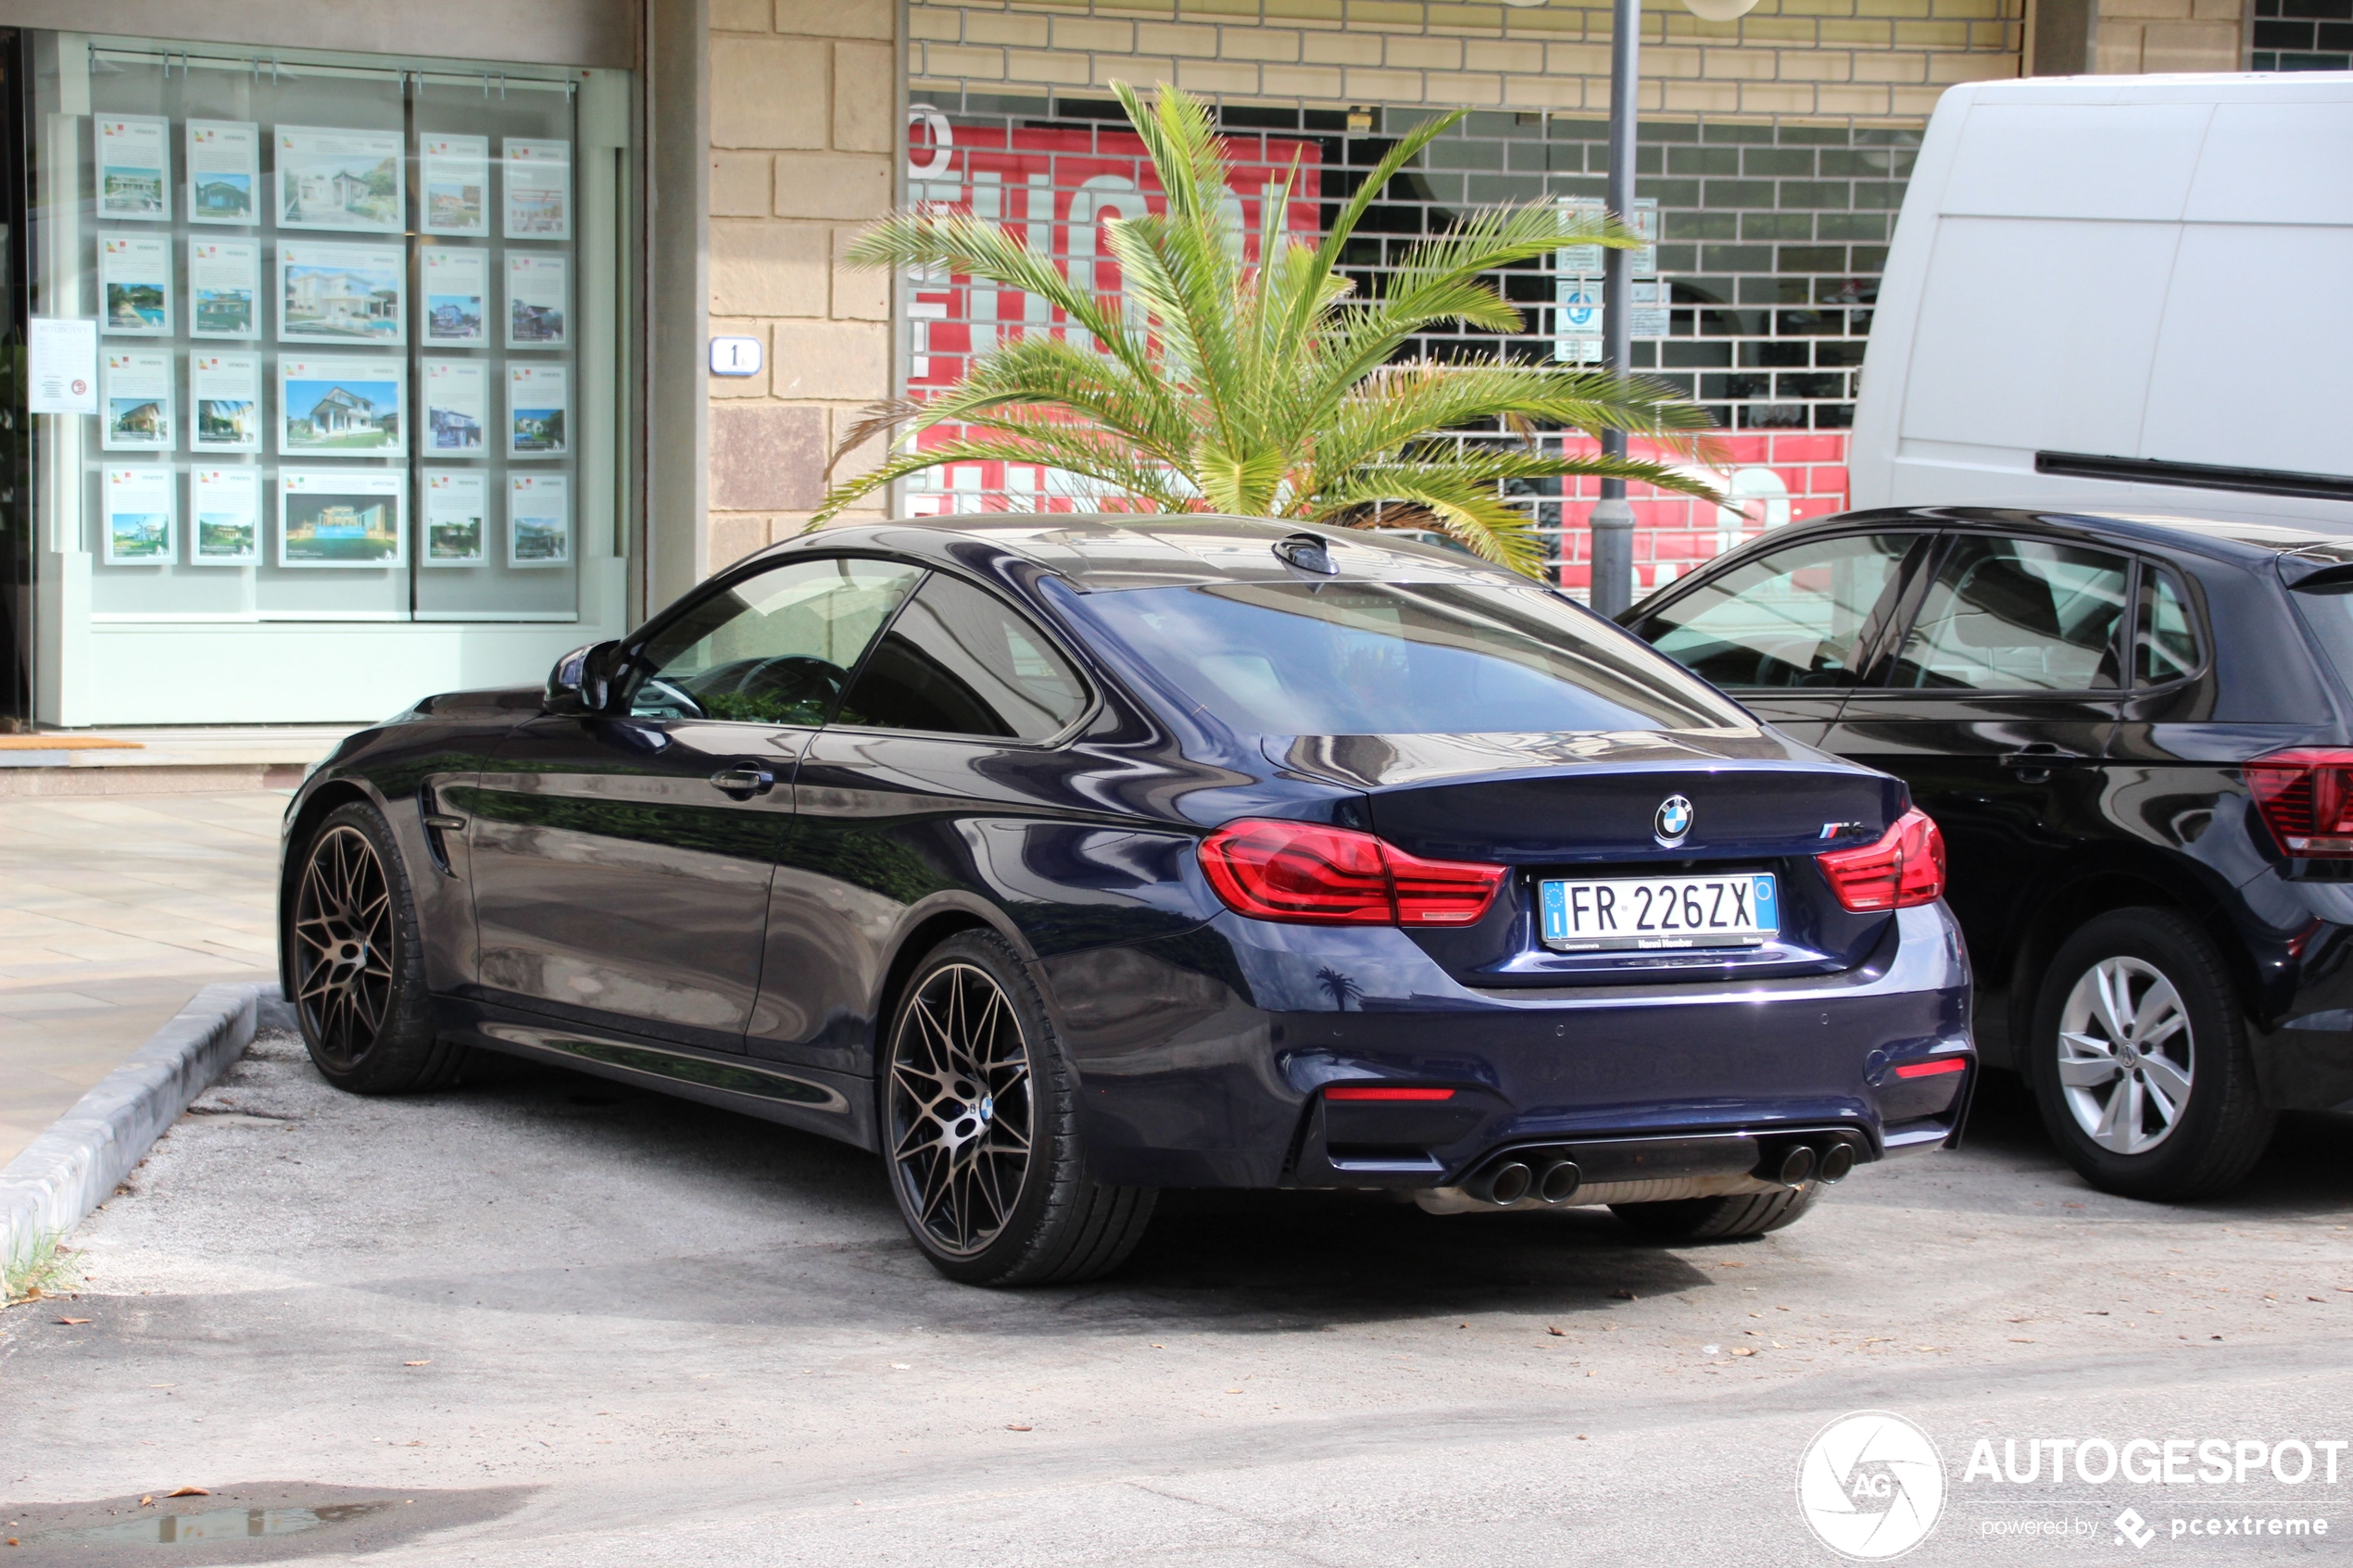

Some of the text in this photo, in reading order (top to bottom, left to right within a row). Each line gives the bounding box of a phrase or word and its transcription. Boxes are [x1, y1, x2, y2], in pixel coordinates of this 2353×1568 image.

[731, 345, 738, 366] 1
[1661, 797, 1692, 813] BMW
[1571, 883, 1751, 932] FR 226ZX
[1638, 938, 1693, 949] Nanni Nember
